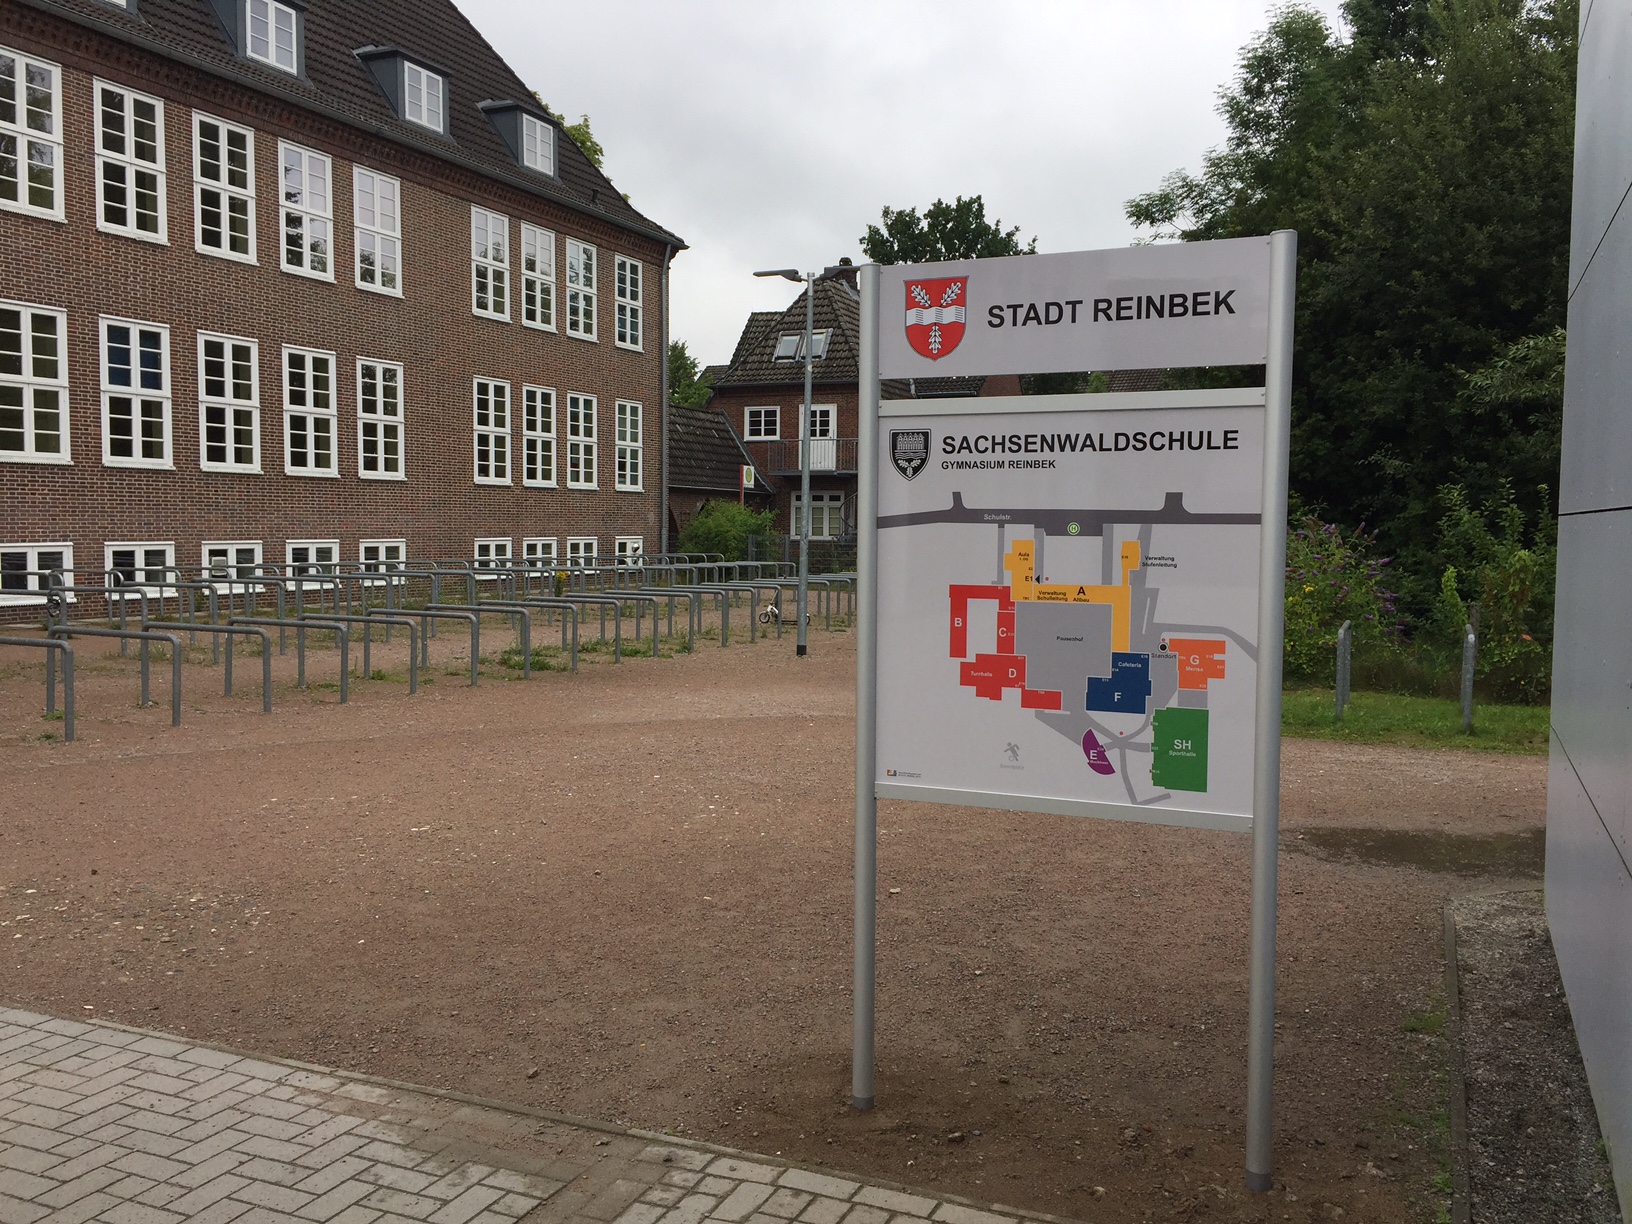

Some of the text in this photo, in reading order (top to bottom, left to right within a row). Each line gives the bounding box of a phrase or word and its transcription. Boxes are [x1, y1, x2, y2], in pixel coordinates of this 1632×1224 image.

[987, 289, 1237, 329] STADT REINBEK
[941, 429, 1240, 455] SACHSENWALDSCHULE
[941, 459, 1056, 470] GYMNASIUM REINBEK
[983, 513, 1013, 521] Schulstr.
[1077, 586, 1086, 596] A
[954, 617, 962, 627] B
[998, 627, 1007, 638] C
[1189, 654, 1200, 666] G
[1008, 668, 1017, 678] D
[1114, 692, 1122, 702] F
[1173, 739, 1192, 750] SH
[1090, 749, 1098, 760] E
